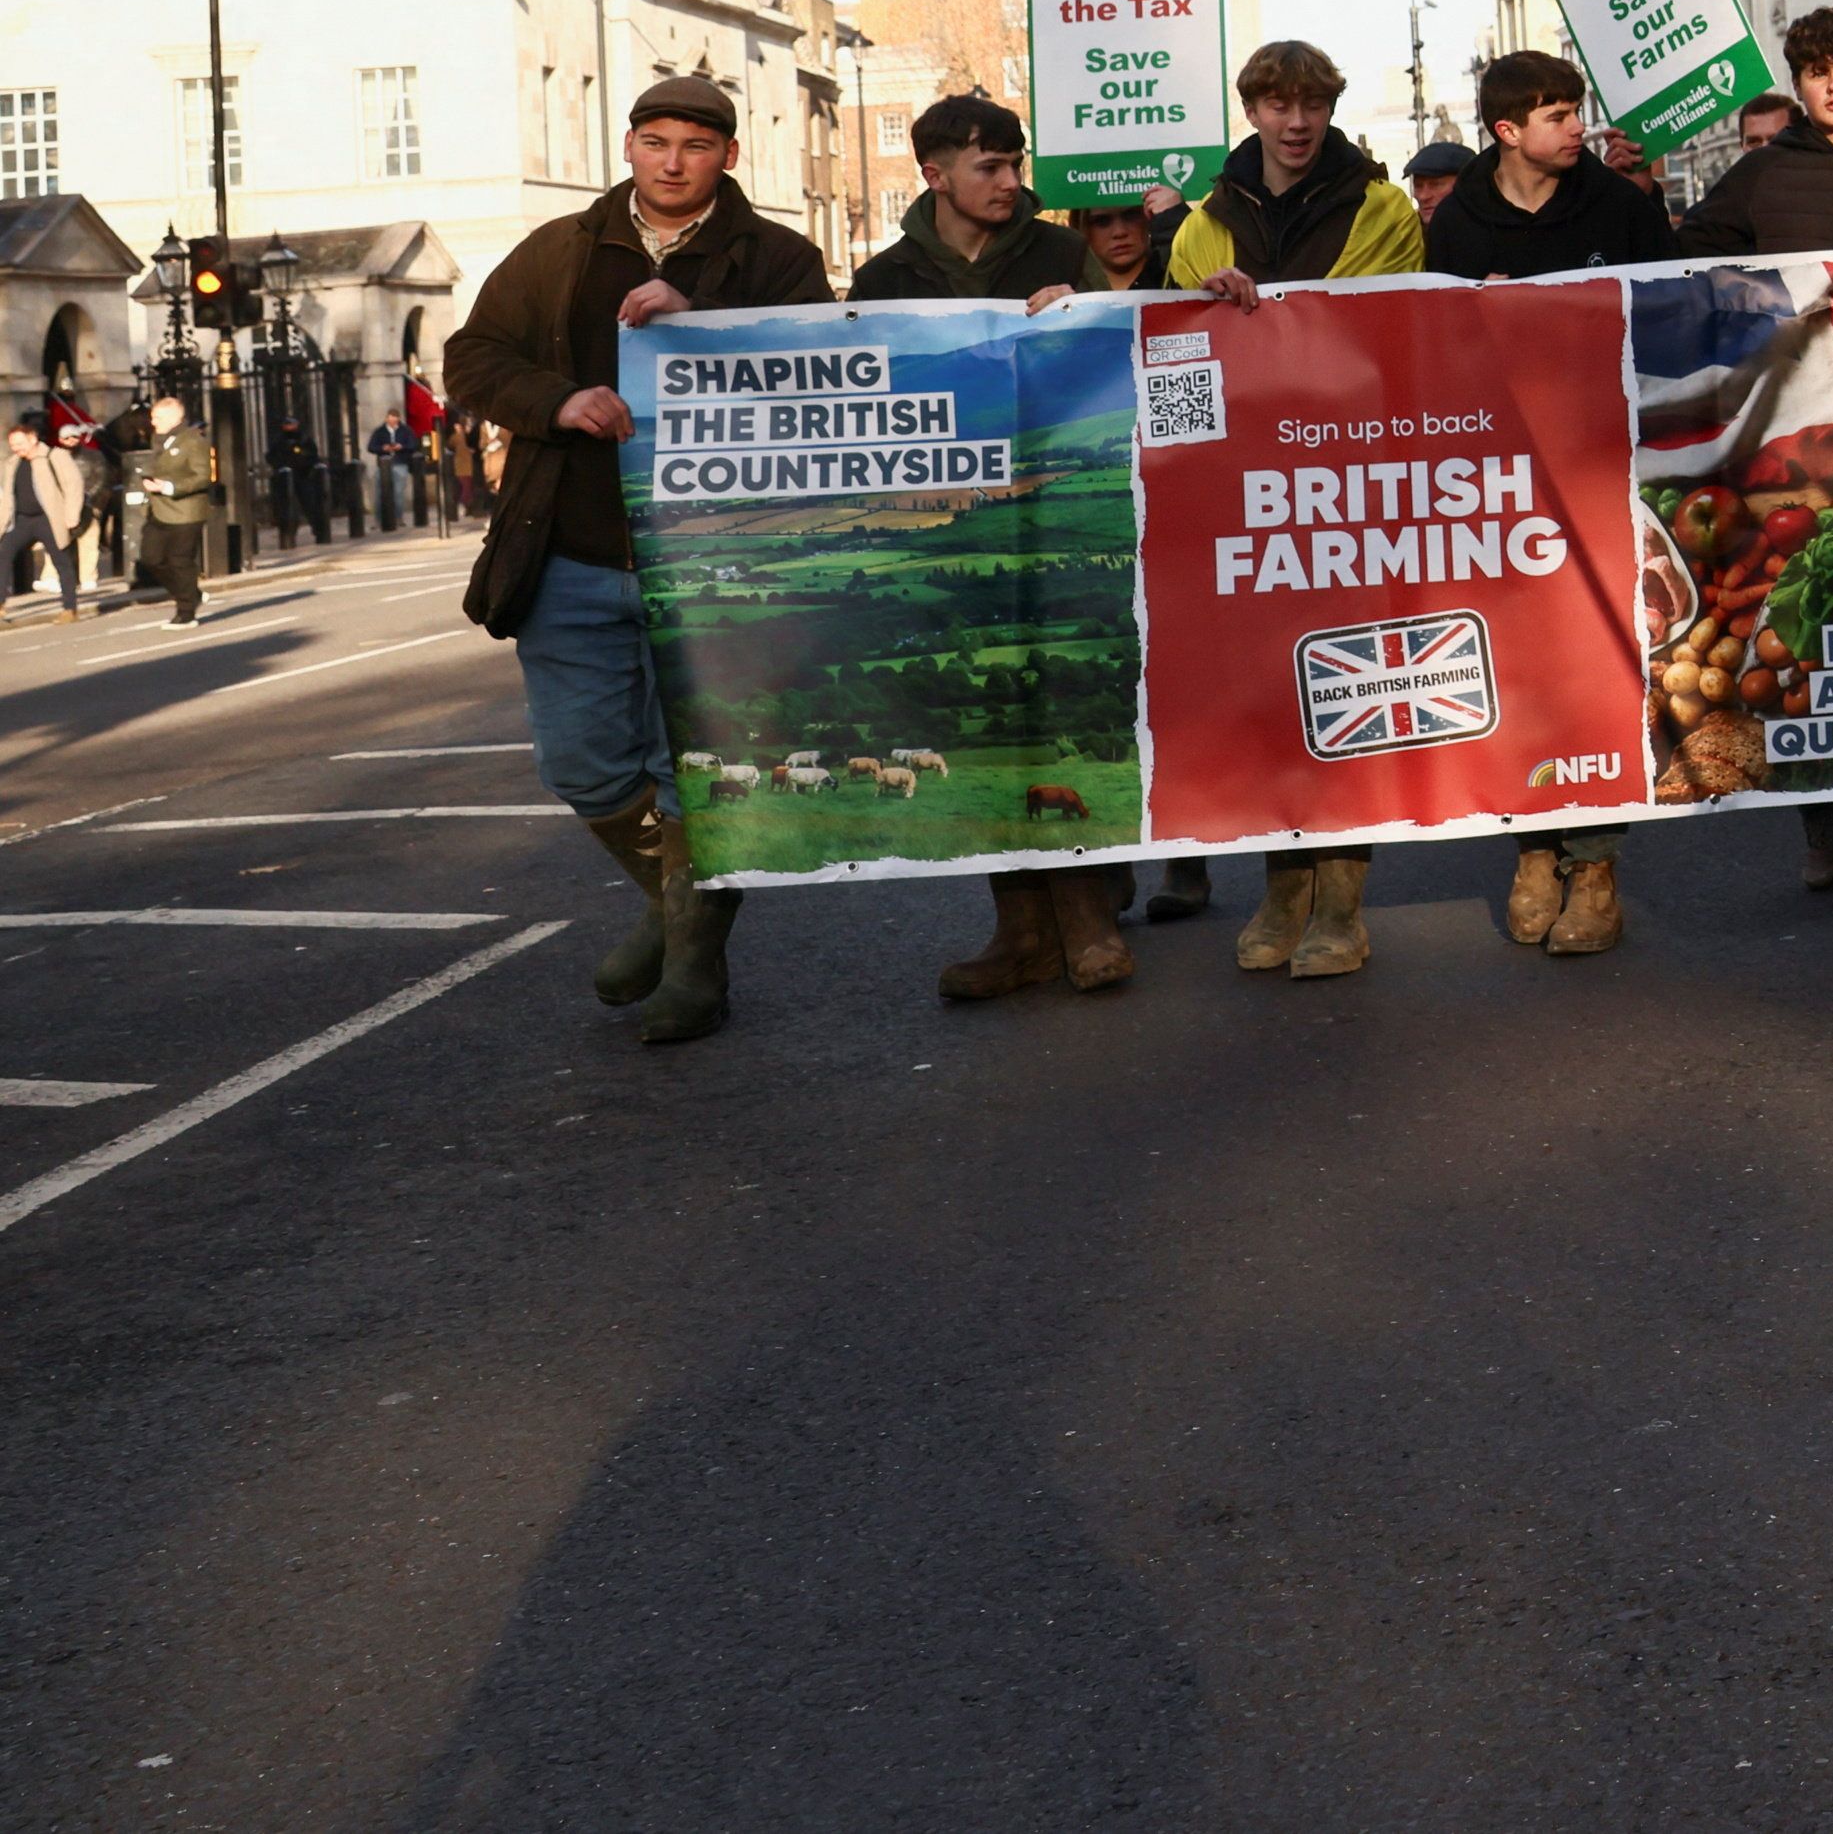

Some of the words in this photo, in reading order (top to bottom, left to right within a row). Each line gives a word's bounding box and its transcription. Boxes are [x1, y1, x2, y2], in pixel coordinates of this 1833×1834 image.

[1632, 0, 1675, 41] our
[1085, 48, 1171, 73] Save
[1620, 14, 1709, 80] Farms
[1100, 78, 1159, 101] our
[1640, 82, 1712, 134] Countryside
[1074, 104, 1187, 129] Farms
[1669, 97, 1718, 134] Alliance
[1067, 165, 1160, 187] Countryside
[1149, 337, 1182, 349] Scan
[1185, 334, 1206, 345] the
[1149, 351, 1169, 363] QR
[1172, 347, 1207, 360] Code
[663, 352, 882, 396] SHAPING
[662, 406, 756, 445] THE
[769, 398, 950, 441] BRITISH
[1278, 419, 1339, 448] Sign
[1348, 420, 1384, 445] up
[1391, 415, 1415, 437] to
[1423, 409, 1494, 436] back
[661, 444, 1005, 495] COUNTRYSIDE
[1243, 454, 1534, 529] BRITISH
[1215, 516, 1568, 596] FARMING
[1312, 685, 1353, 704] BACK
[1357, 677, 1412, 697] BRITISH
[1414, 666, 1481, 689] FARMING
[1555, 752, 1621, 786] NFU
